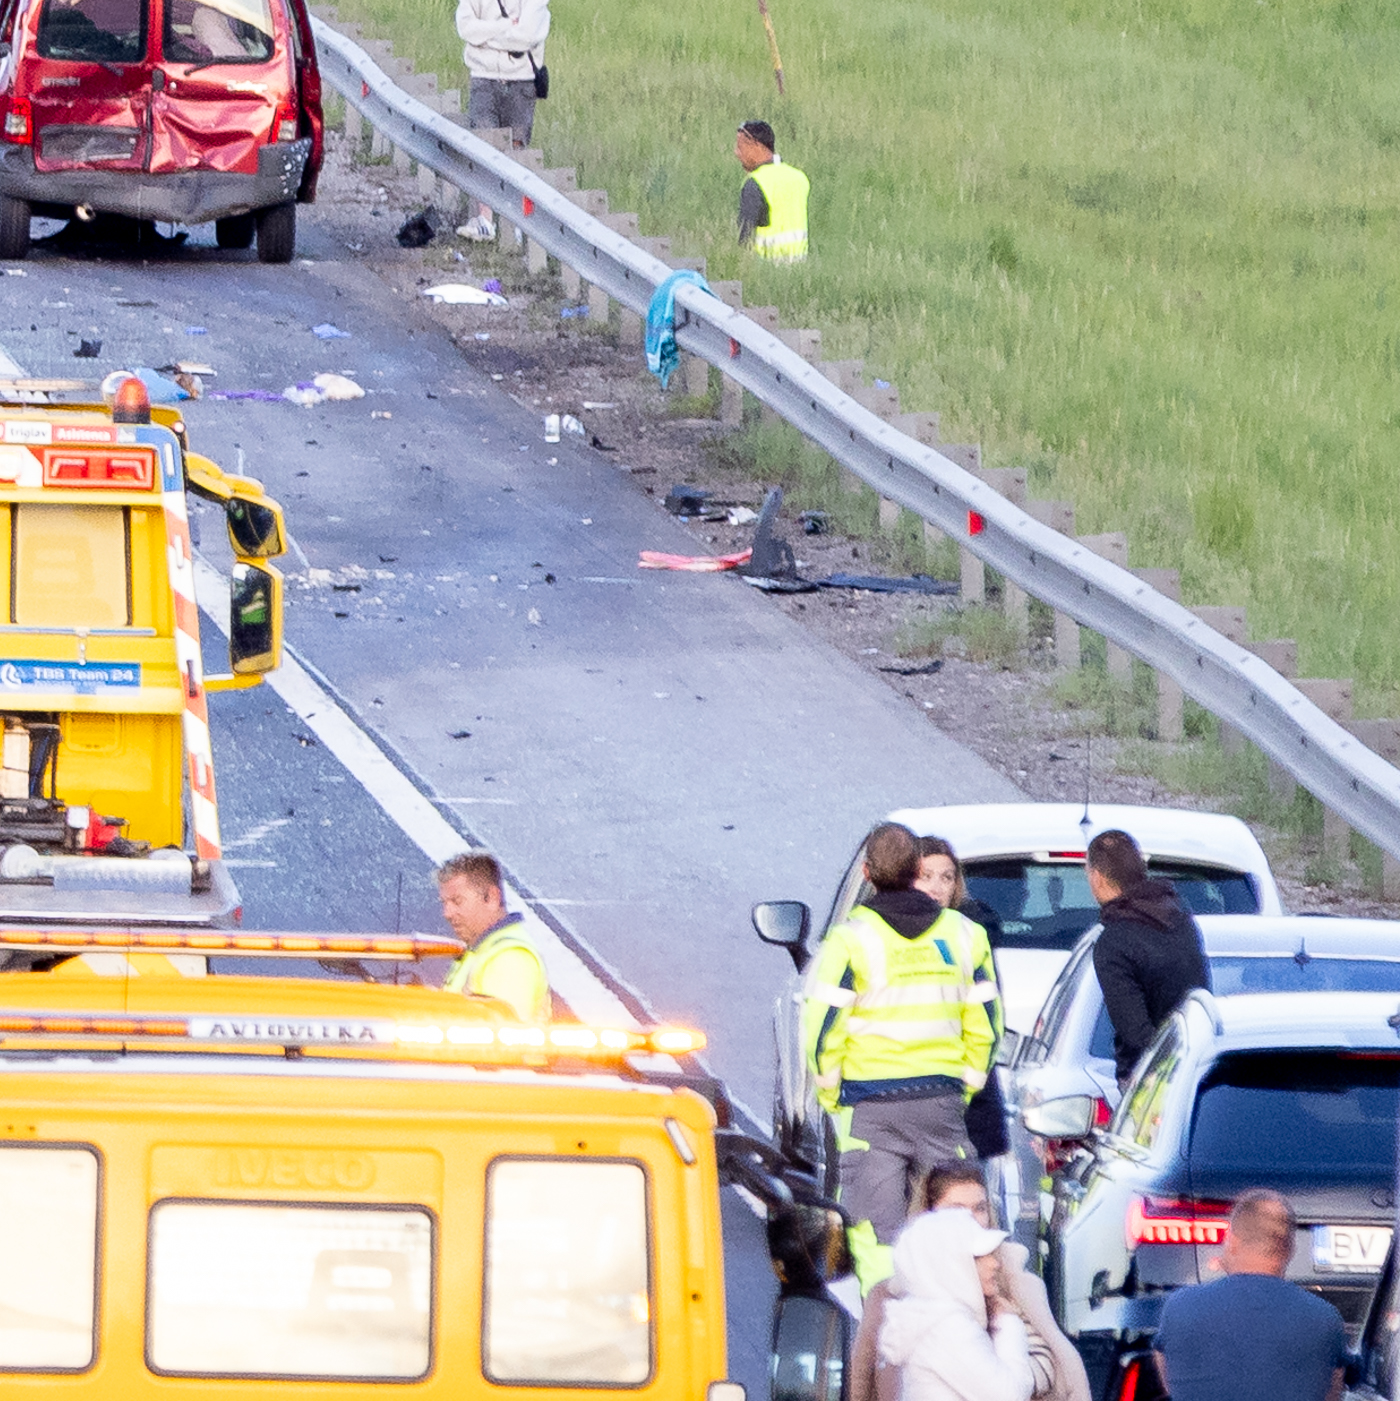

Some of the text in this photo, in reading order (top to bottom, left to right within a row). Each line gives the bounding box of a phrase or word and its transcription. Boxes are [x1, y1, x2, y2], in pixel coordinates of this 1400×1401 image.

[68, 668, 110, 682] Team
[212, 1148, 378, 1192] IVECO
[1333, 1231, 1376, 1260] BV
